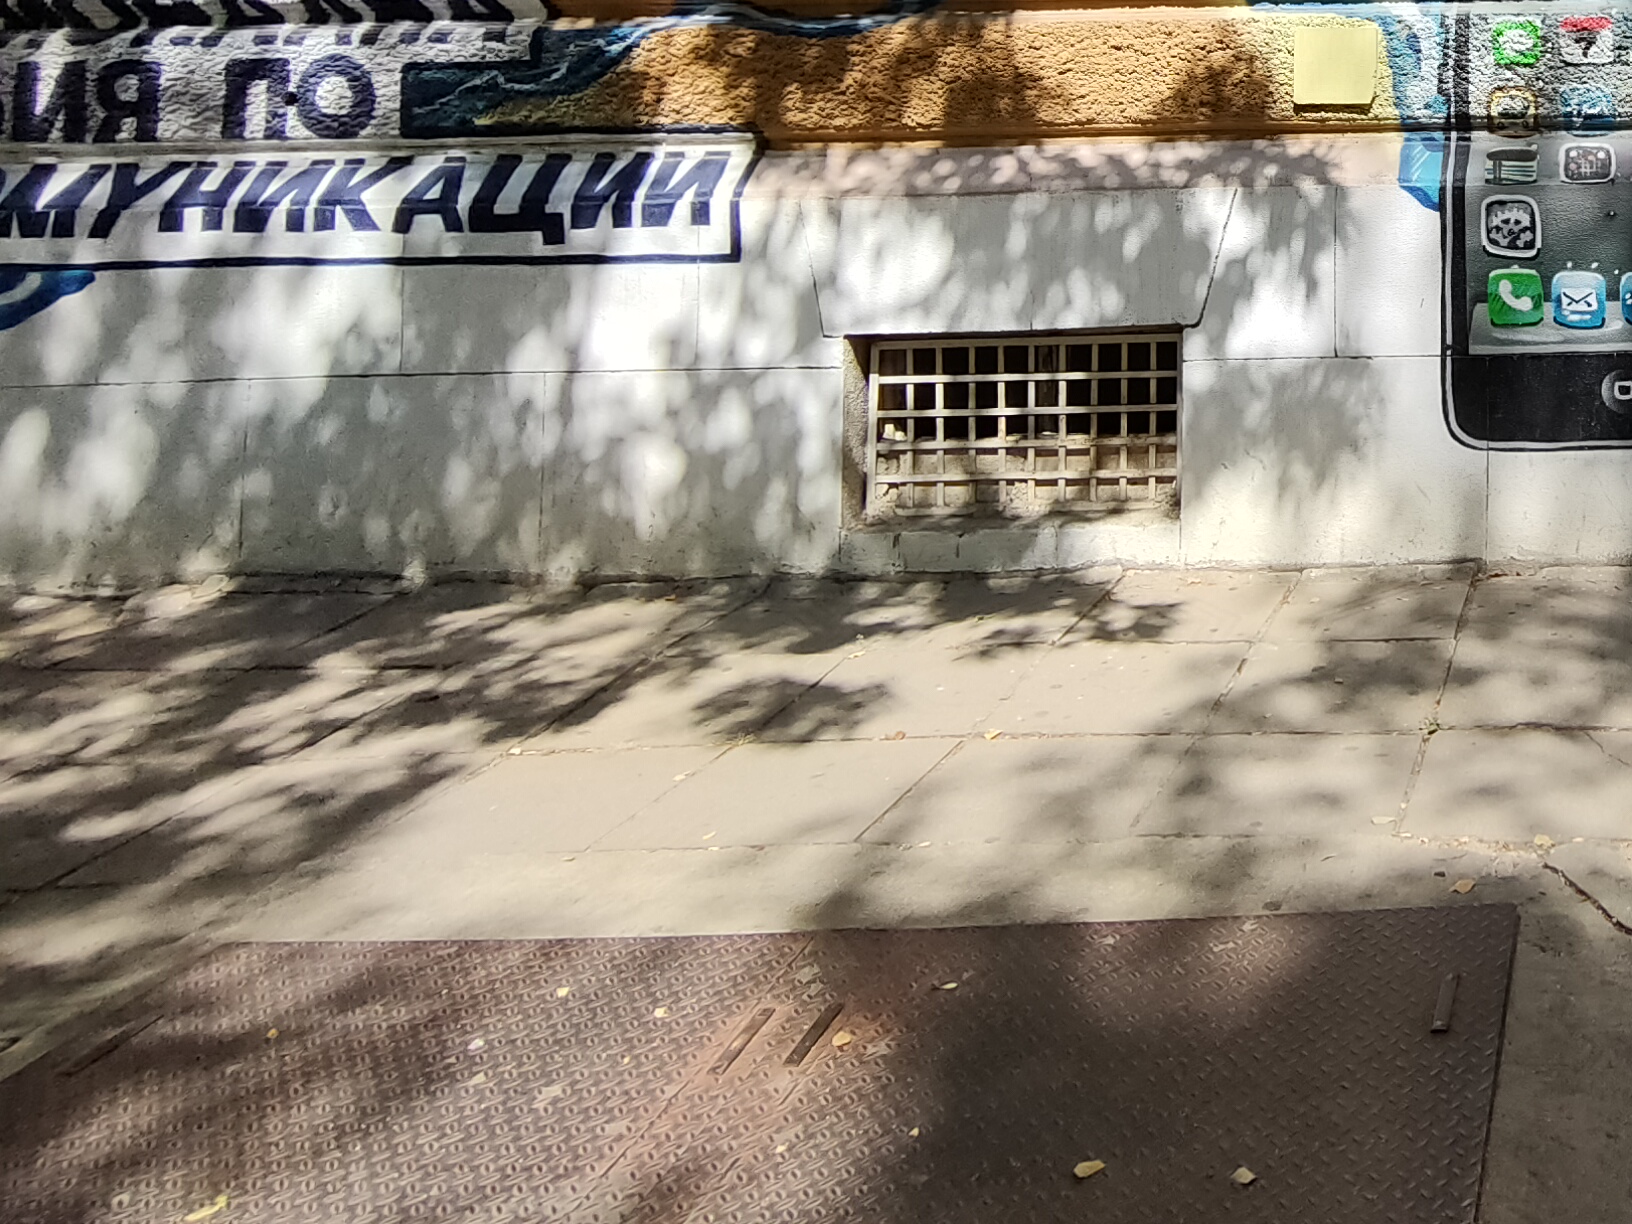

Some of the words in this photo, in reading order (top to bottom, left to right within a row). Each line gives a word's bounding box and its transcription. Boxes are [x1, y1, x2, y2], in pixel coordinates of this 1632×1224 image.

[0, 58, 164, 144] ИЯ
[221, 52, 378, 141] ПО
[0, 151, 732, 246] МУНИКАЦИИ
